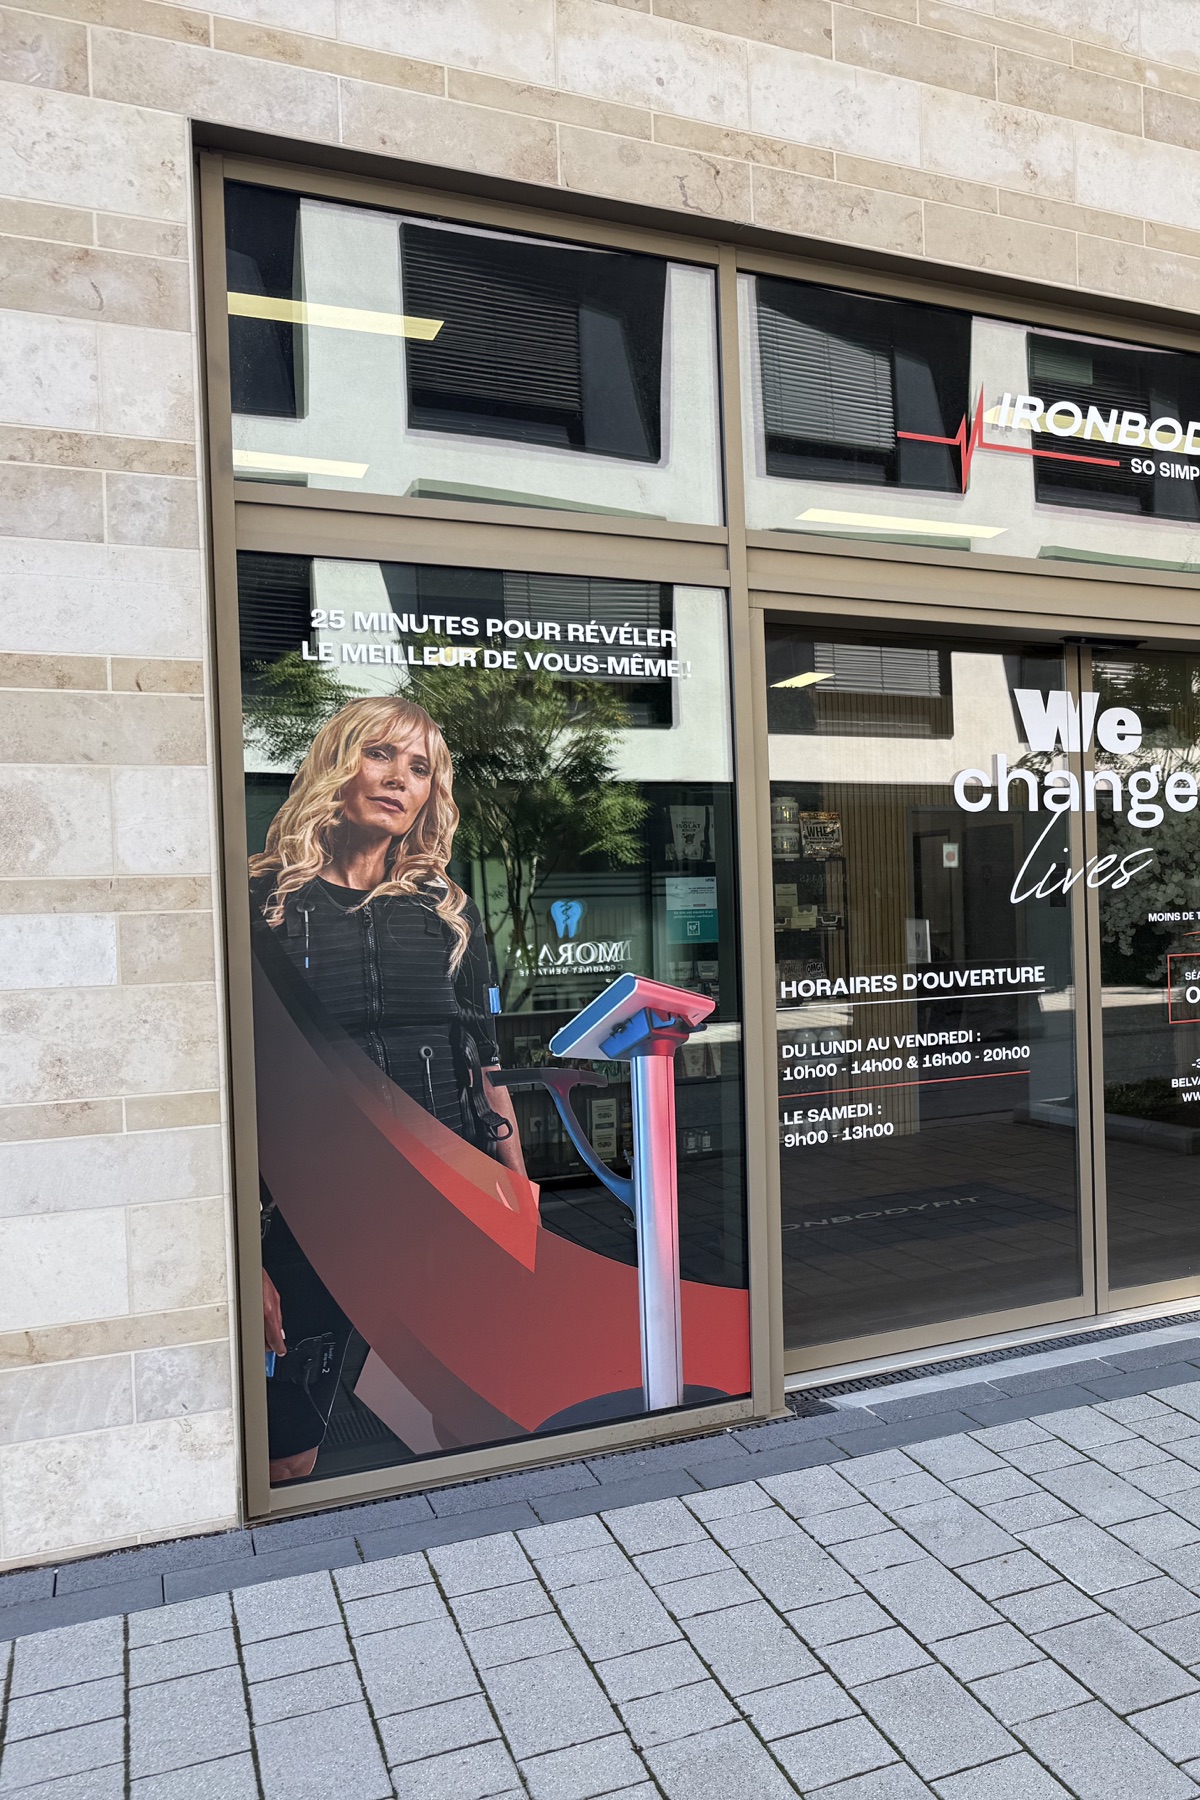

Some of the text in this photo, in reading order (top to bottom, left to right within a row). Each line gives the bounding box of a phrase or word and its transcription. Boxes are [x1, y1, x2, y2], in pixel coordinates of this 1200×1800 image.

[1130, 458, 1156, 475] SO
[310, 608, 677, 648] 25 MINUTES POUR RÉVÉLER
[302, 641, 335, 661] LE
[342, 643, 477, 668] MEILLEUR
[483, 650, 518, 670] DE
[524, 651, 681, 678] VOUS-MÊME
[1013, 688, 1143, 755] We
[953, 753, 1199, 829] change
[1010, 810, 1154, 905] lives
[1148, 911, 1181, 923] MOINS
[1182, 911, 1195, 921] DE
[780, 965, 1046, 999] HORAIRES D'OUVERTURE
[781, 1043, 807, 1059] DU
[811, 1038, 862, 1056] LUNDI
[866, 1036, 890, 1051] AU
[893, 1030, 973, 1049] VENDREDI
[782, 1063, 838, 1081] 10h00
[850, 1057, 903, 1075] 14h00
[906, 1056, 919, 1070] &
[922, 1049, 972, 1067] 16h00
[983, 1045, 1031, 1063] 20h00
[783, 1110, 804, 1126] LE
[807, 1102, 873, 1123] SAMEDI
[784, 1130, 829, 1148] 9h00
[841, 1122, 894, 1141] 13h00
